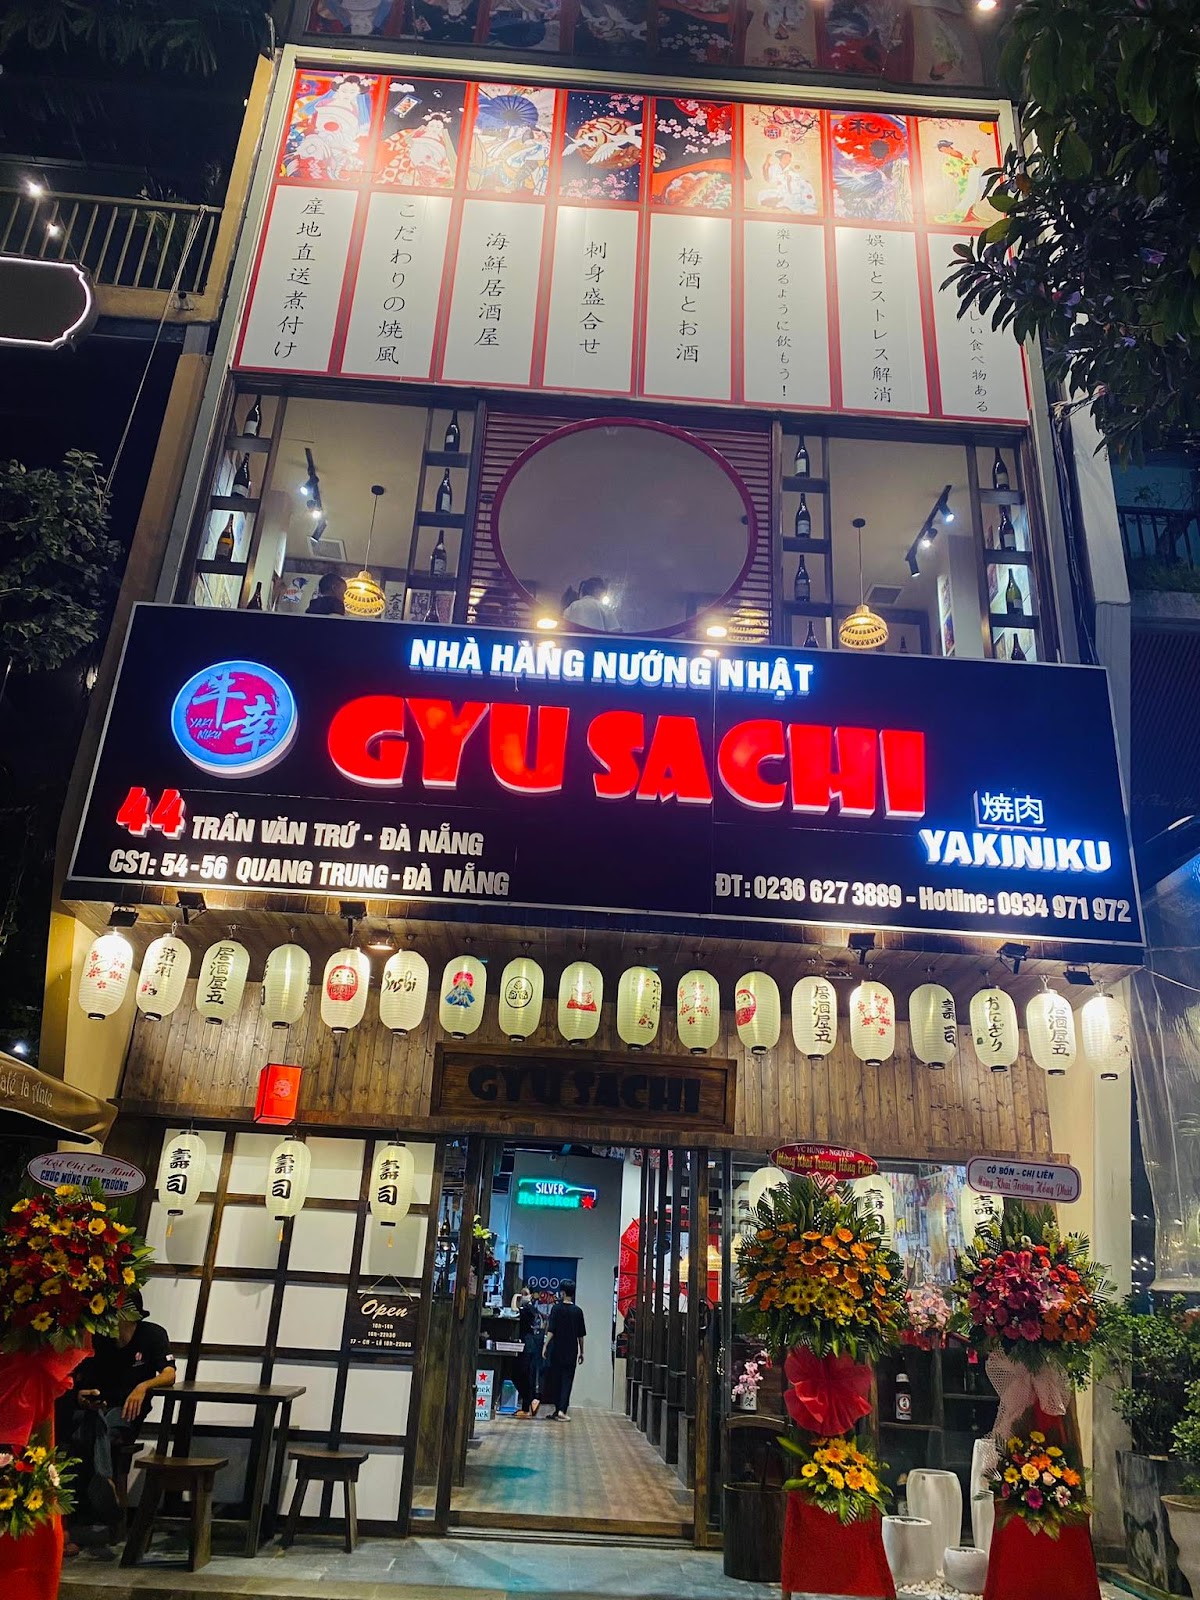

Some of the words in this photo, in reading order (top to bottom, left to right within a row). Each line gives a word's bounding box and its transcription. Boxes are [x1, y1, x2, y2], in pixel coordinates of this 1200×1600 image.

[273, 197, 326, 359] 産地直送煮付け
[375, 201, 415, 364] こだわりの焼風
[474, 231, 511, 347] 海鮮居酒屋
[579, 241, 608, 355] 刺身盛合せ
[676, 247, 703, 363] 梅酒とお酒
[866, 234, 893, 403] 娯楽とストレス解消
[409, 637, 482, 674] NHÀ
[490, 640, 585, 681] HÀNG
[591, 649, 711, 690] NƯỚNG
[718, 657, 814, 700] NHẬT
[190, 717, 214, 728] YAKI
[196, 728, 222, 740] NIKU
[328, 695, 570, 792] GYU
[587, 710, 926, 820] SACHI
[116, 787, 186, 838] 44
[192, 811, 255, 842] TRẦN
[261, 815, 307, 846] VĂN
[314, 820, 360, 849] TRỨ
[380, 823, 411, 852] ĐÀ
[418, 822, 484, 856] NẴNG
[982, 791, 1044, 825] 焼肉
[109, 849, 157, 875] CS1:
[160, 852, 228, 879] 54-56
[236, 856, 314, 884] QUANG
[443, 862, 510, 896] NẴNG
[919, 828, 1112, 872] YAKINIKU
[809, 879, 849, 905] 627
[851, 882, 902, 908] 3889
[919, 886, 995, 914] Hotline:
[997, 891, 1049, 917] 0934
[1053, 894, 1089, 920] 971
[1092, 897, 1132, 922] 972
[985, 996, 1005, 1052] おにぎり
[21, 1075, 30, 1097] la
[467, 1064, 562, 1105] GYU
[573, 1071, 701, 1114] SACHI
[535, 1182, 564, 1196] SILVER
[987, 1165, 997, 1174] CÔ
[517, 1191, 580, 1208] Heineken
[361, 1299, 408, 1320] Open
